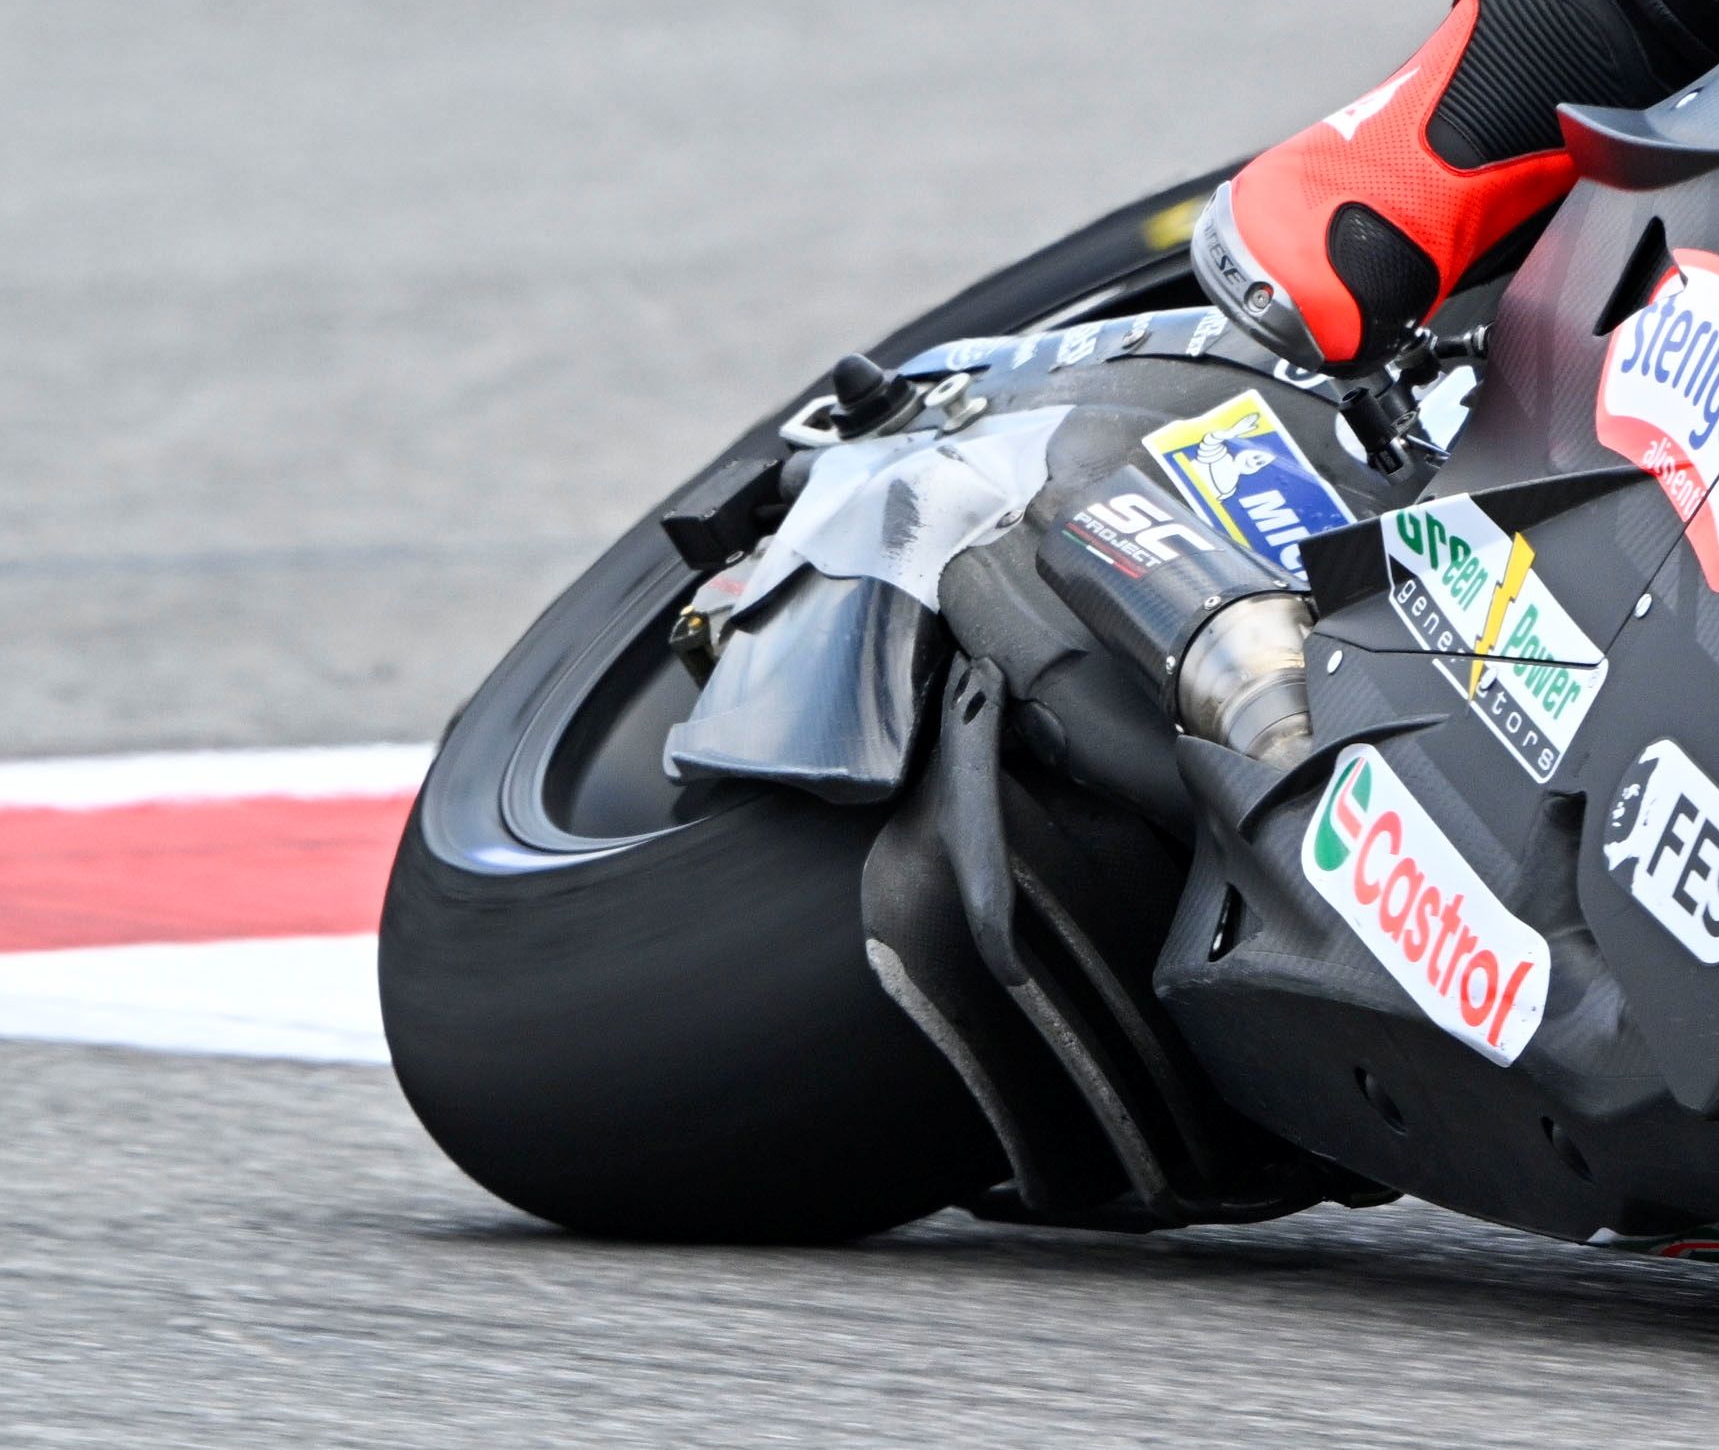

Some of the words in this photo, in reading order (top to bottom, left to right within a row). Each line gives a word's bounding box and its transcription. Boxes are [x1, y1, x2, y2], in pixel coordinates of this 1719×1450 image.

[1072, 511, 1162, 567] PROJECT
[1086, 492, 1216, 562] SC
[1395, 507, 1489, 613] Green
[1500, 602, 1582, 721] Power
[1353, 809, 1534, 1049] Castrol
